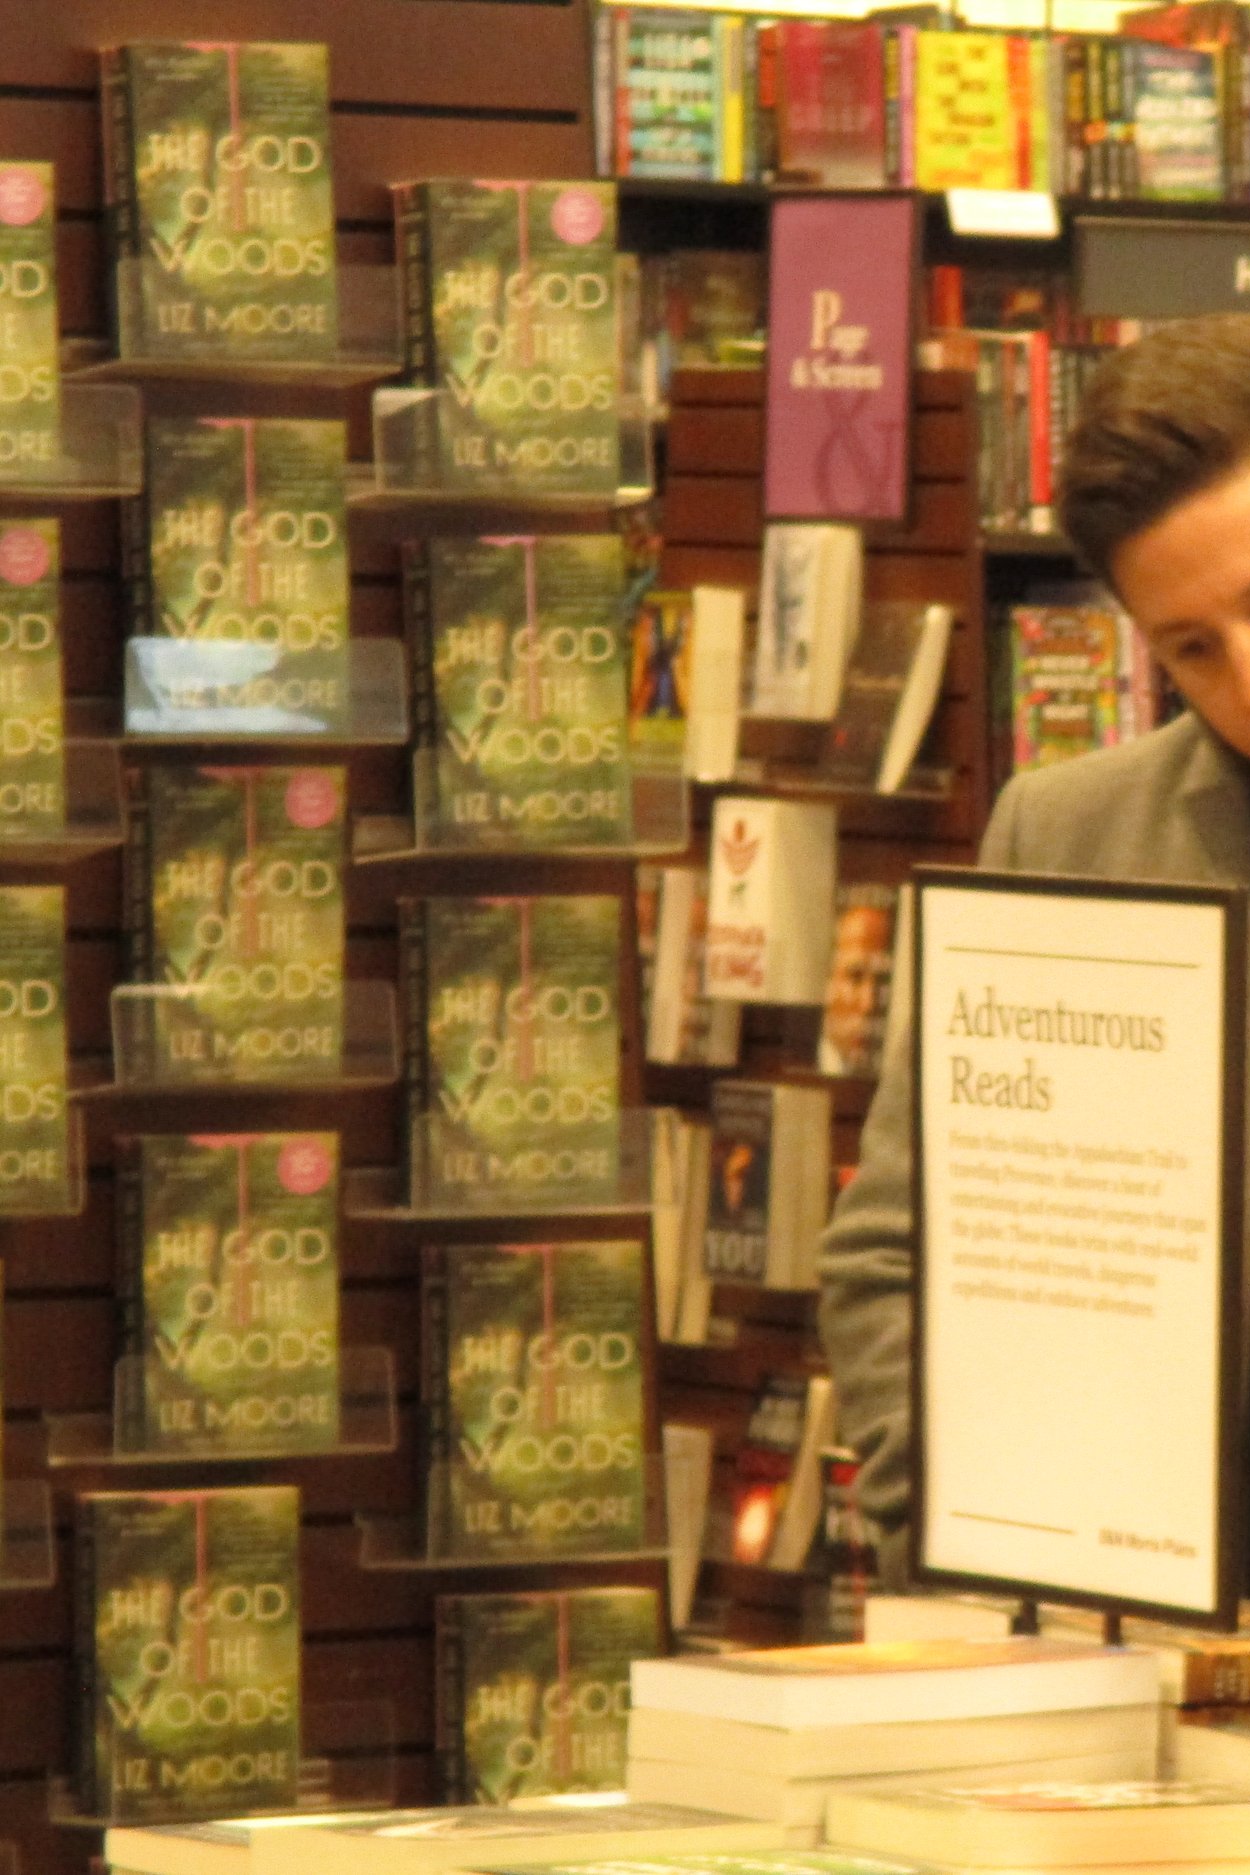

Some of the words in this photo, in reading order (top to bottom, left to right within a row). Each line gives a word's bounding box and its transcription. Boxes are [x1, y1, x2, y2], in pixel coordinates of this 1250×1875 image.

[215, 133, 323, 173] GOD
[180, 186, 231, 224] OF
[148, 238, 328, 276] WOODS
[505, 272, 609, 310] GOD
[203, 302, 328, 334] MOORE
[810, 288, 869, 361] Page
[471, 323, 518, 360] OF
[444, 373, 613, 411] WOODS
[494, 436, 613, 467] MOORE
[230, 511, 336, 549] GOD
[193, 560, 243, 598] OF
[161, 612, 341, 651] WOODS
[511, 627, 616, 663] GOD
[212, 678, 337, 708] MOORE
[475, 679, 524, 714] OF
[446, 727, 622, 764] WOODS
[500, 789, 622, 821] MOORE
[230, 860, 335, 898] GOD
[195, 912, 243, 950] OF
[162, 962, 338, 1001] WOODS
[505, 985, 609, 1022] GOD
[946, 987, 1167, 1053] Adventurous
[213, 1026, 334, 1059] MOORE
[470, 1037, 517, 1074] OF
[948, 1055, 1054, 1113] Reads
[437, 1084, 614, 1124] WOODS
[486, 1149, 611, 1181] MOORE
[221, 1227, 331, 1265] GOD
[185, 1281, 234, 1320] OF
[152, 1329, 335, 1370] WOODS
[527, 1332, 636, 1370] GOD
[203, 1394, 329, 1429] MOORE
[490, 1385, 540, 1424] OF
[458, 1433, 638, 1474] WOODS
[510, 1496, 635, 1530] MOORE
[178, 1582, 290, 1624] GOD
[140, 1640, 193, 1678] OF
[106, 1686, 291, 1730] WOODS
[160, 1752, 291, 1788] MOORE
